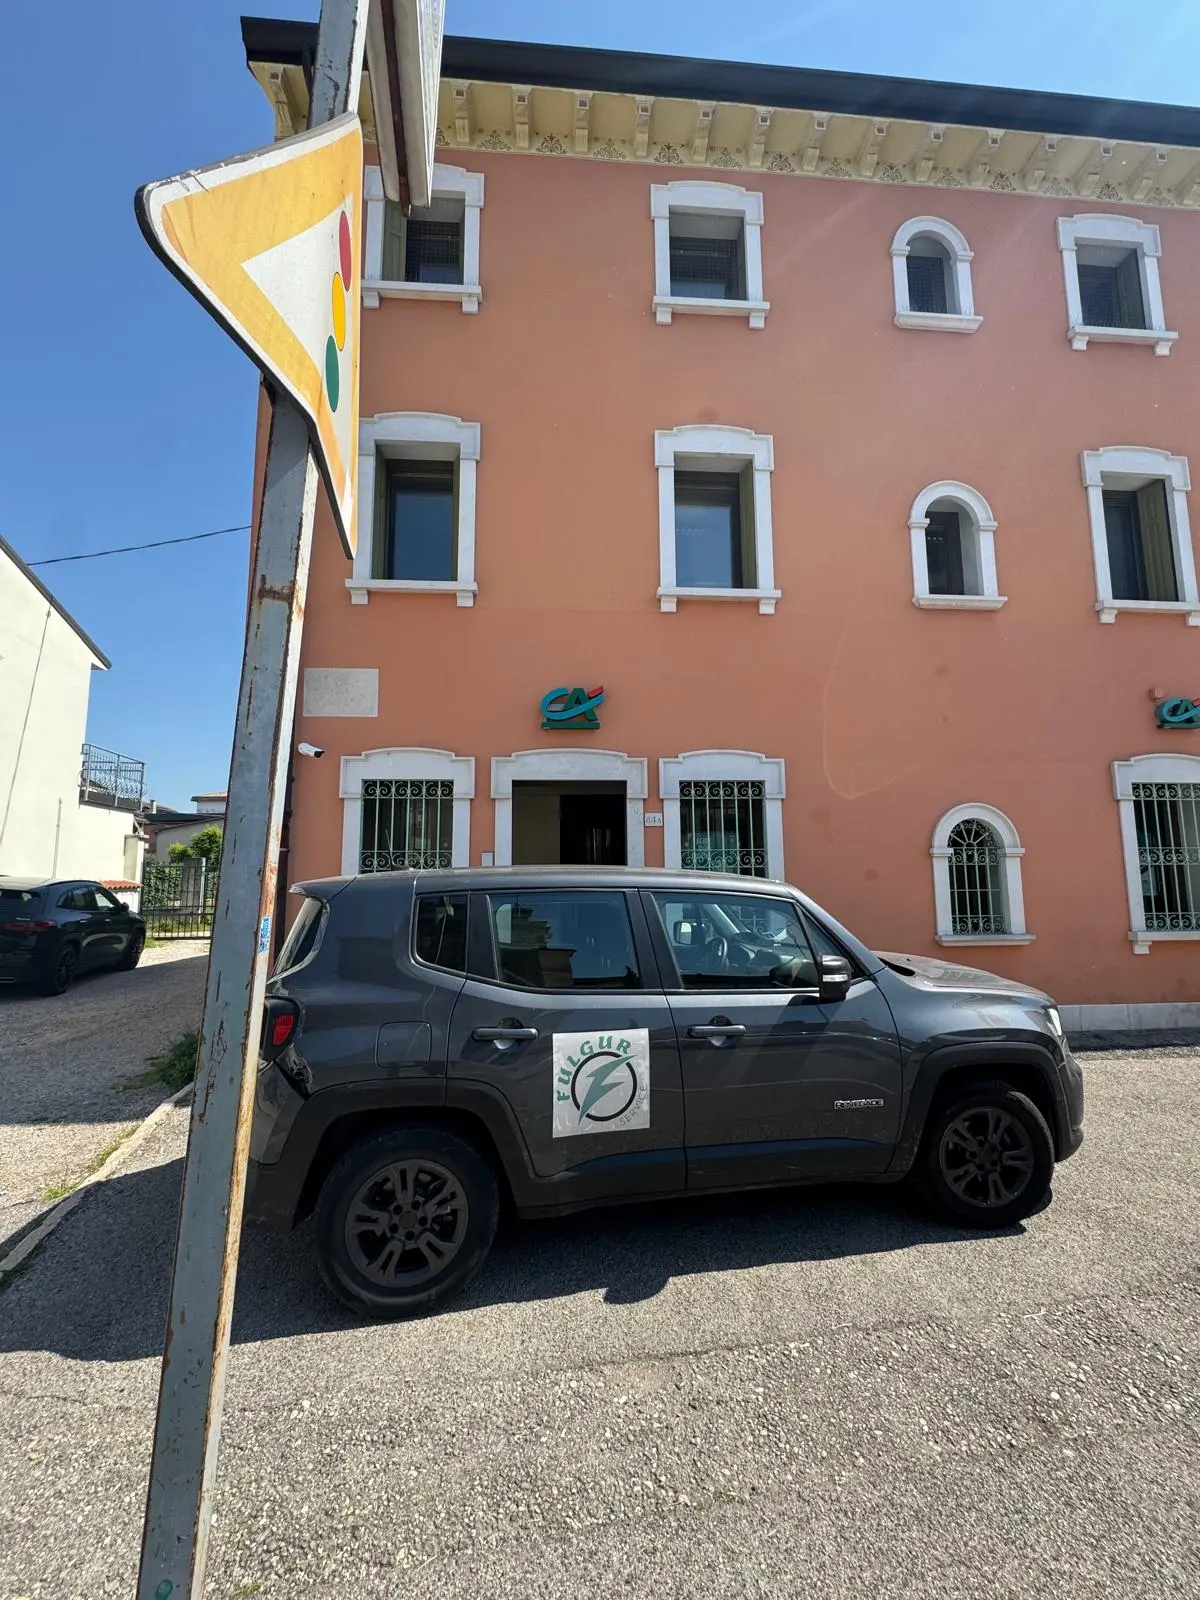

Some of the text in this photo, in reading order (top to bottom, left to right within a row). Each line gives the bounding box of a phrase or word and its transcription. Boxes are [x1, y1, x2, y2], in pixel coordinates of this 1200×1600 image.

[541, 686, 605, 721] CA
[557, 1036, 631, 1101] FULGUR
[619, 1085, 648, 1126] SERVICE
[834, 1099, 883, 1109] RENEGADE
